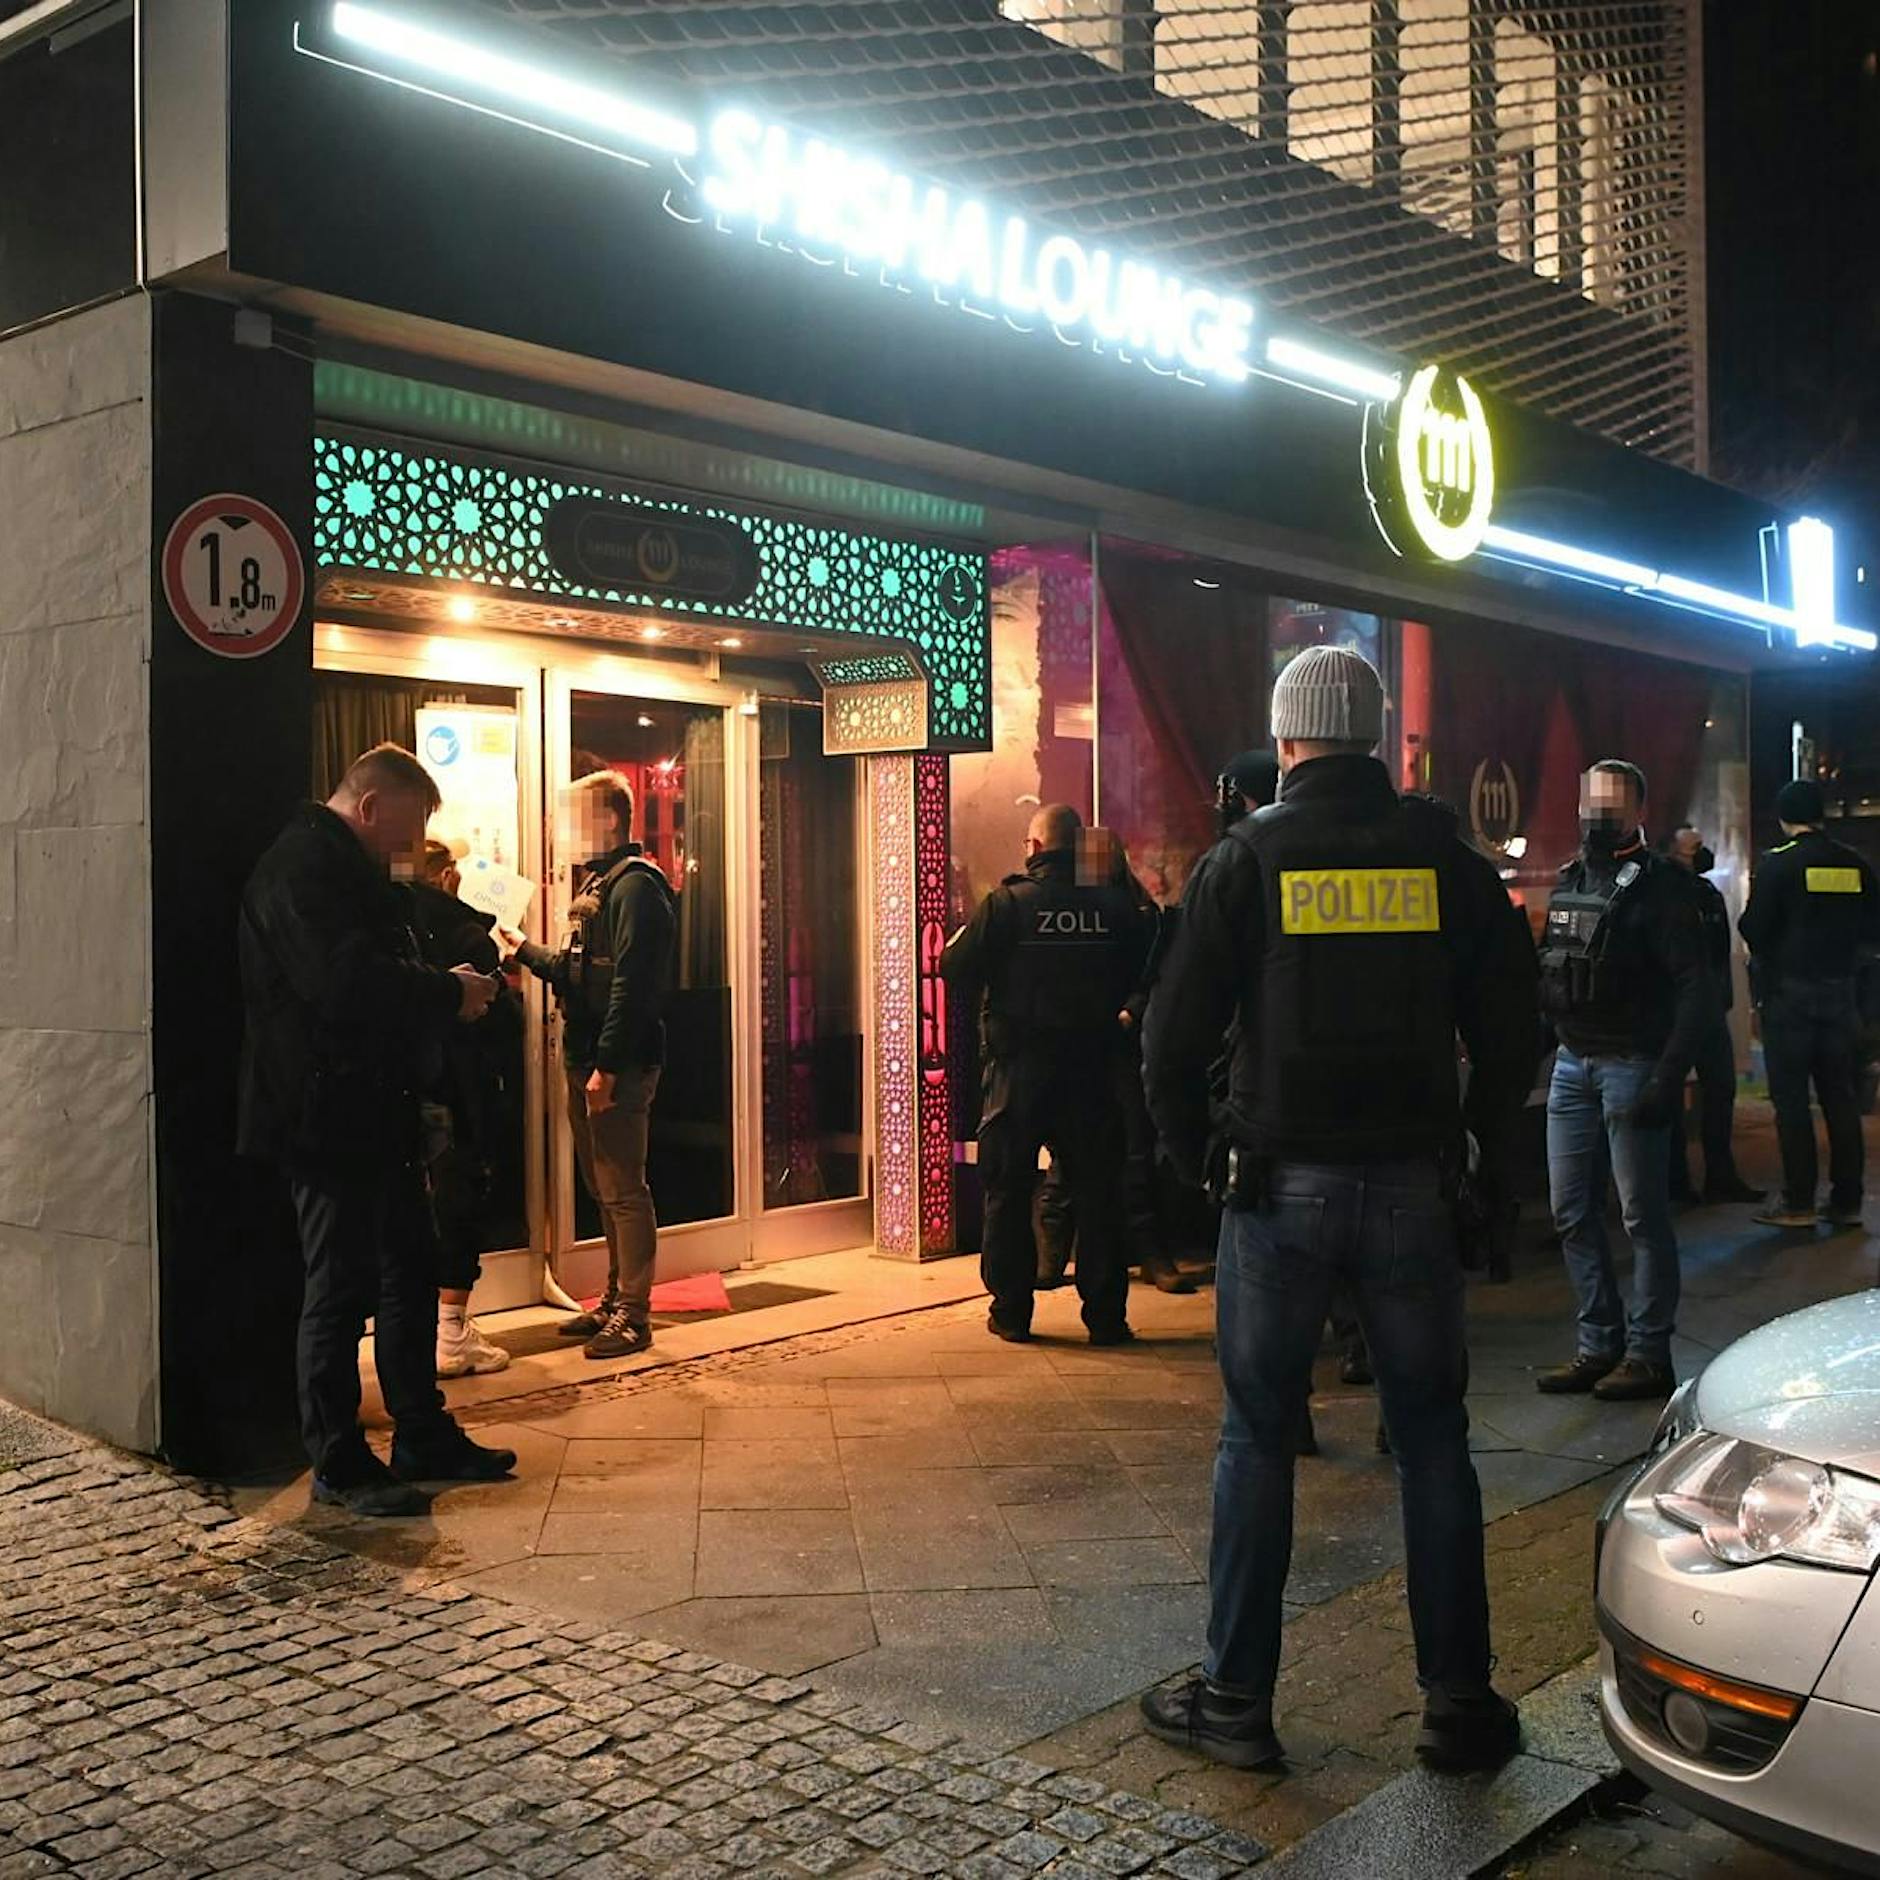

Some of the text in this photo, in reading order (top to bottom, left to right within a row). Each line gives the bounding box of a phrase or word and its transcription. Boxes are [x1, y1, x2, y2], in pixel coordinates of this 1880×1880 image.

[701, 106, 1257, 384] SHISHA LOUNGE
[1036, 910, 1110, 934] ZOLL
[1290, 878, 1432, 924] POLIZEI
